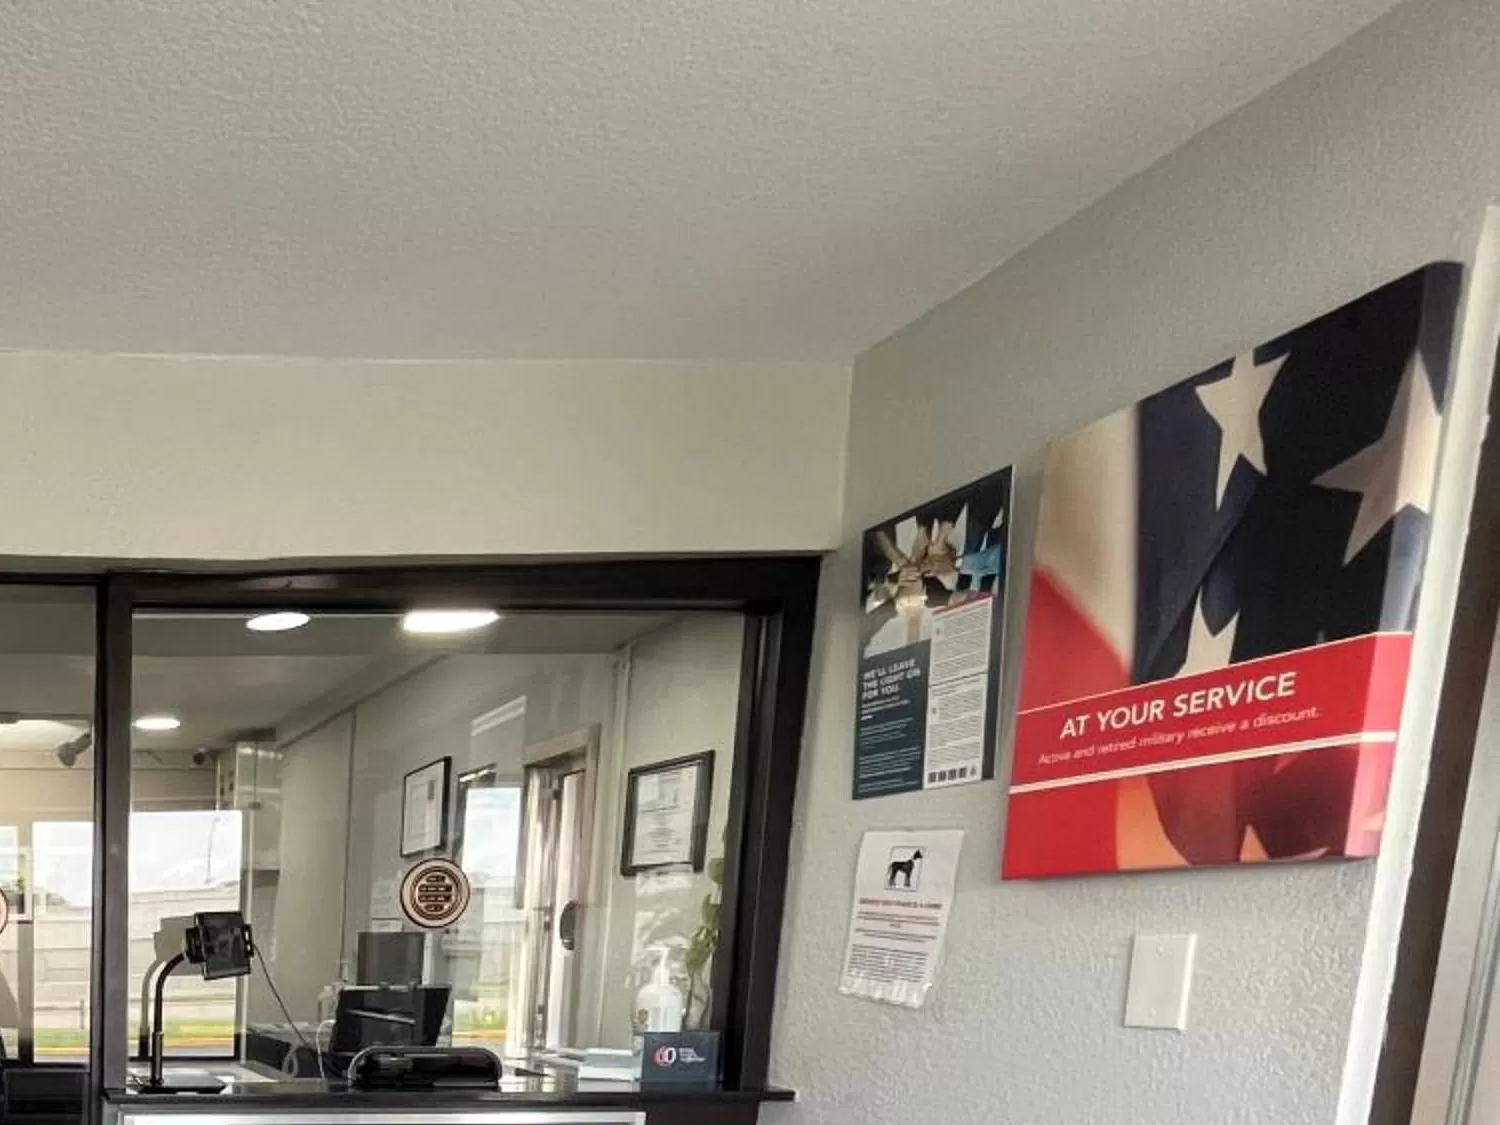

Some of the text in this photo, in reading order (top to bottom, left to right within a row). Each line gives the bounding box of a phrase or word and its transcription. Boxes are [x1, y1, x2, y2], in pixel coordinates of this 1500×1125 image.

[1060, 671, 1297, 739] AT YOUR SERVICE
[1073, 744, 1096, 759] and
[1098, 736, 1137, 754] retired
[1140, 731, 1185, 747] military
[1187, 720, 1237, 740] receive
[1239, 719, 1250, 731] a
[1253, 706, 1322, 728] discount.
